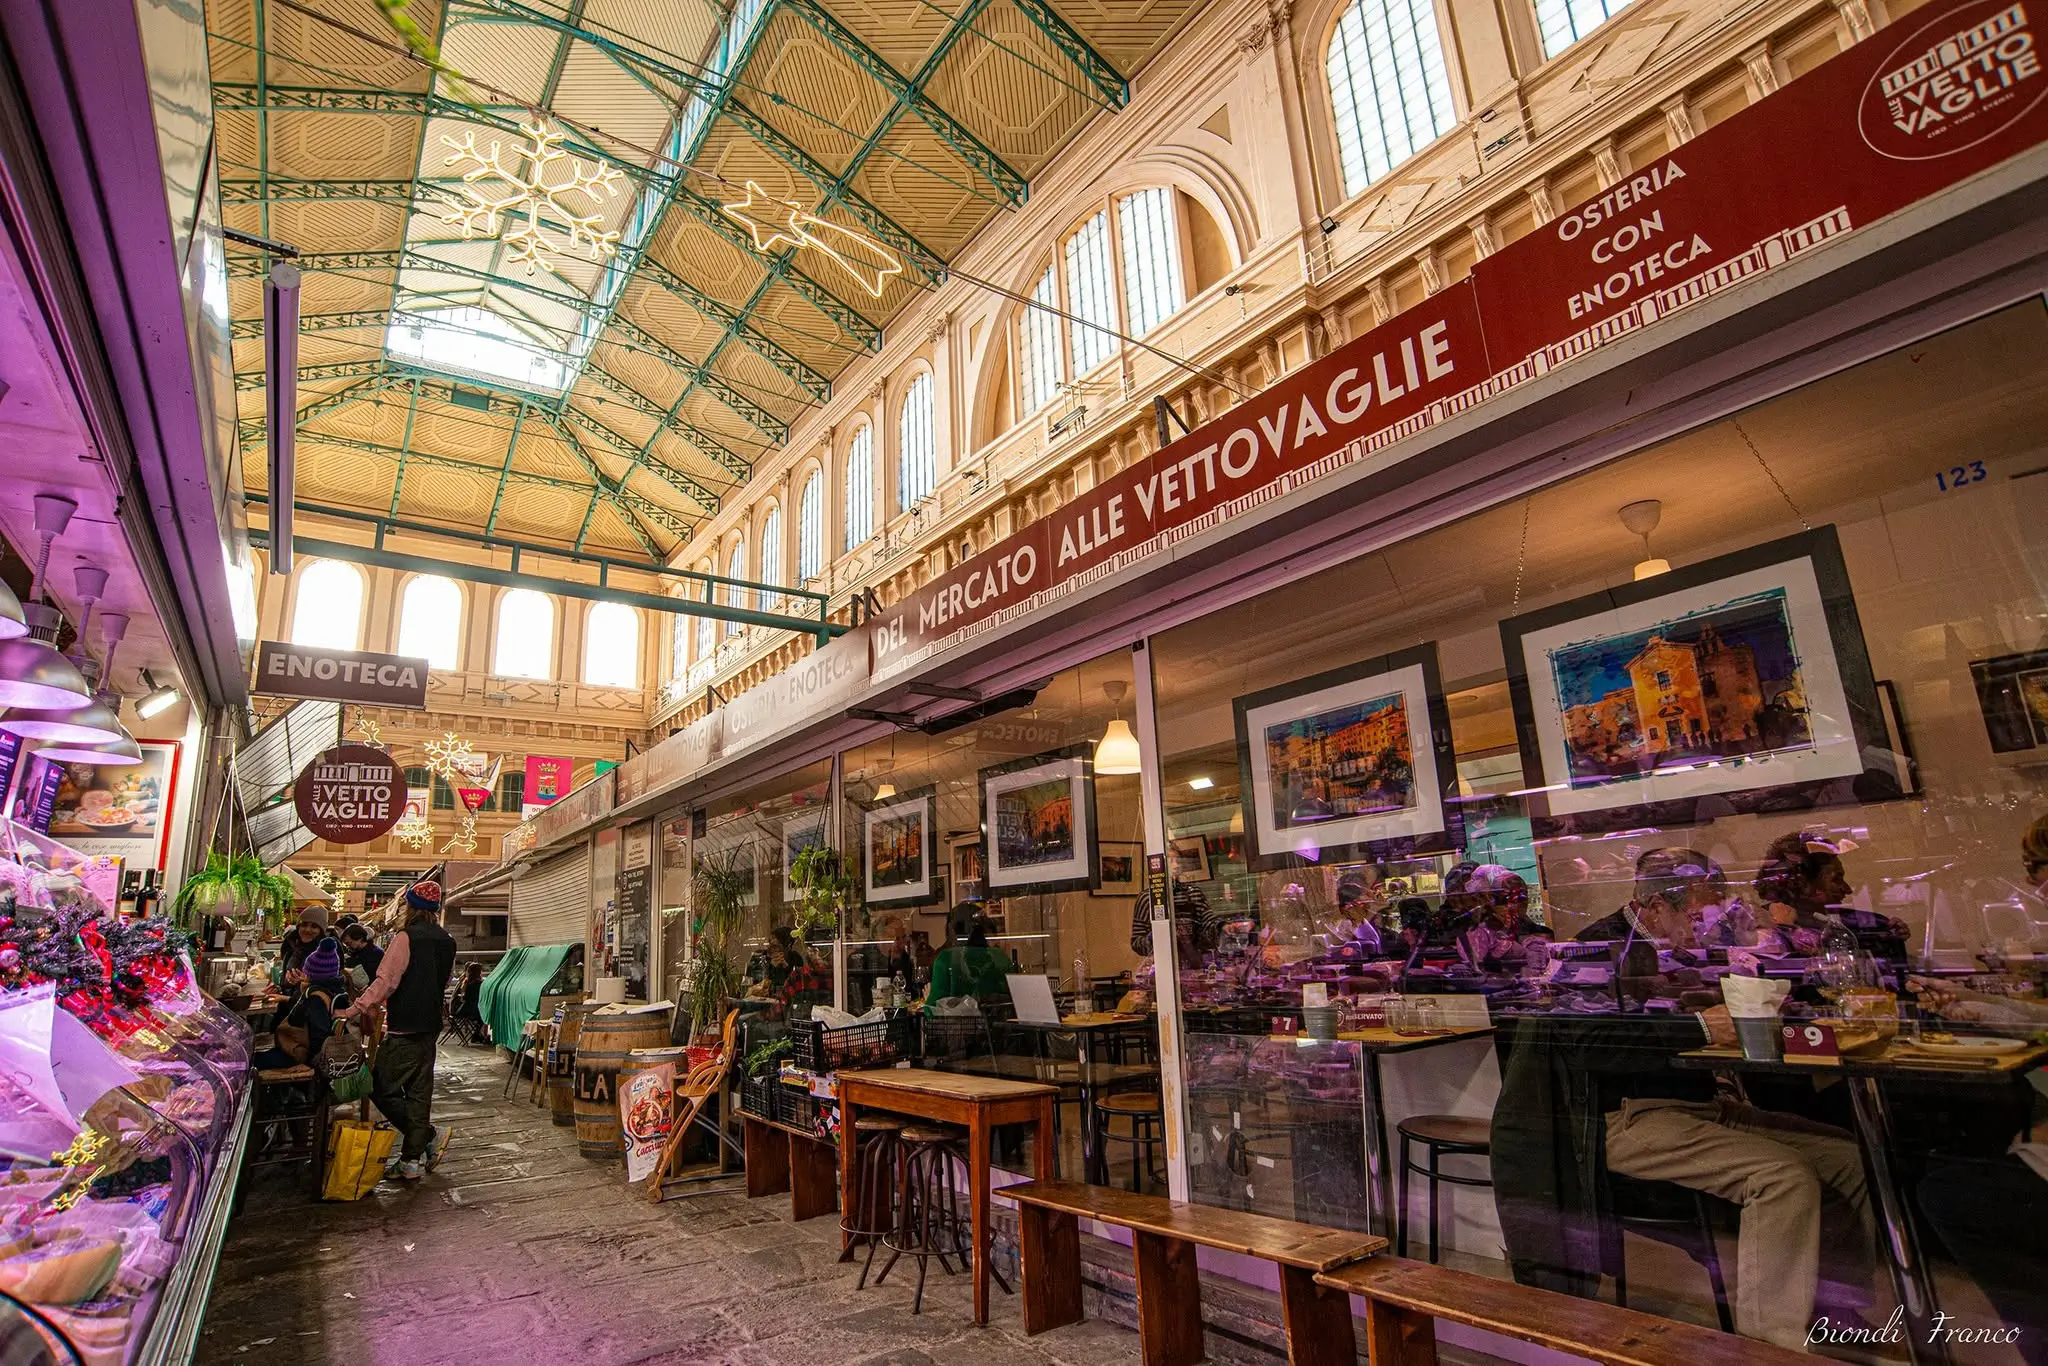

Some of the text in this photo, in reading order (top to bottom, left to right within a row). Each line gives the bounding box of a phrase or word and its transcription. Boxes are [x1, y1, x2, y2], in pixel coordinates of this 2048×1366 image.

[1904, 32, 2033, 107] VETTO
[1893, 51, 2041, 135] VAGLIE
[1954, 112, 1975, 125] VINO
[1558, 159, 1686, 241] OSTERIA
[1591, 209, 1664, 264] CON
[1567, 233, 1712, 321] ENOTECA
[877, 319, 1455, 660] DEL MERCATO ALLE VETTOVAGLIE
[1935, 460, 1987, 491] 123
[267, 653, 418, 689] ENOTECA
[789, 651, 854, 705] ENOTECA
[311, 802, 390, 819] VAGLIE
[322, 785, 391, 801] VETTO
[1282, 1017, 1292, 1031] 7
[1803, 1026, 1824, 1047] 9
